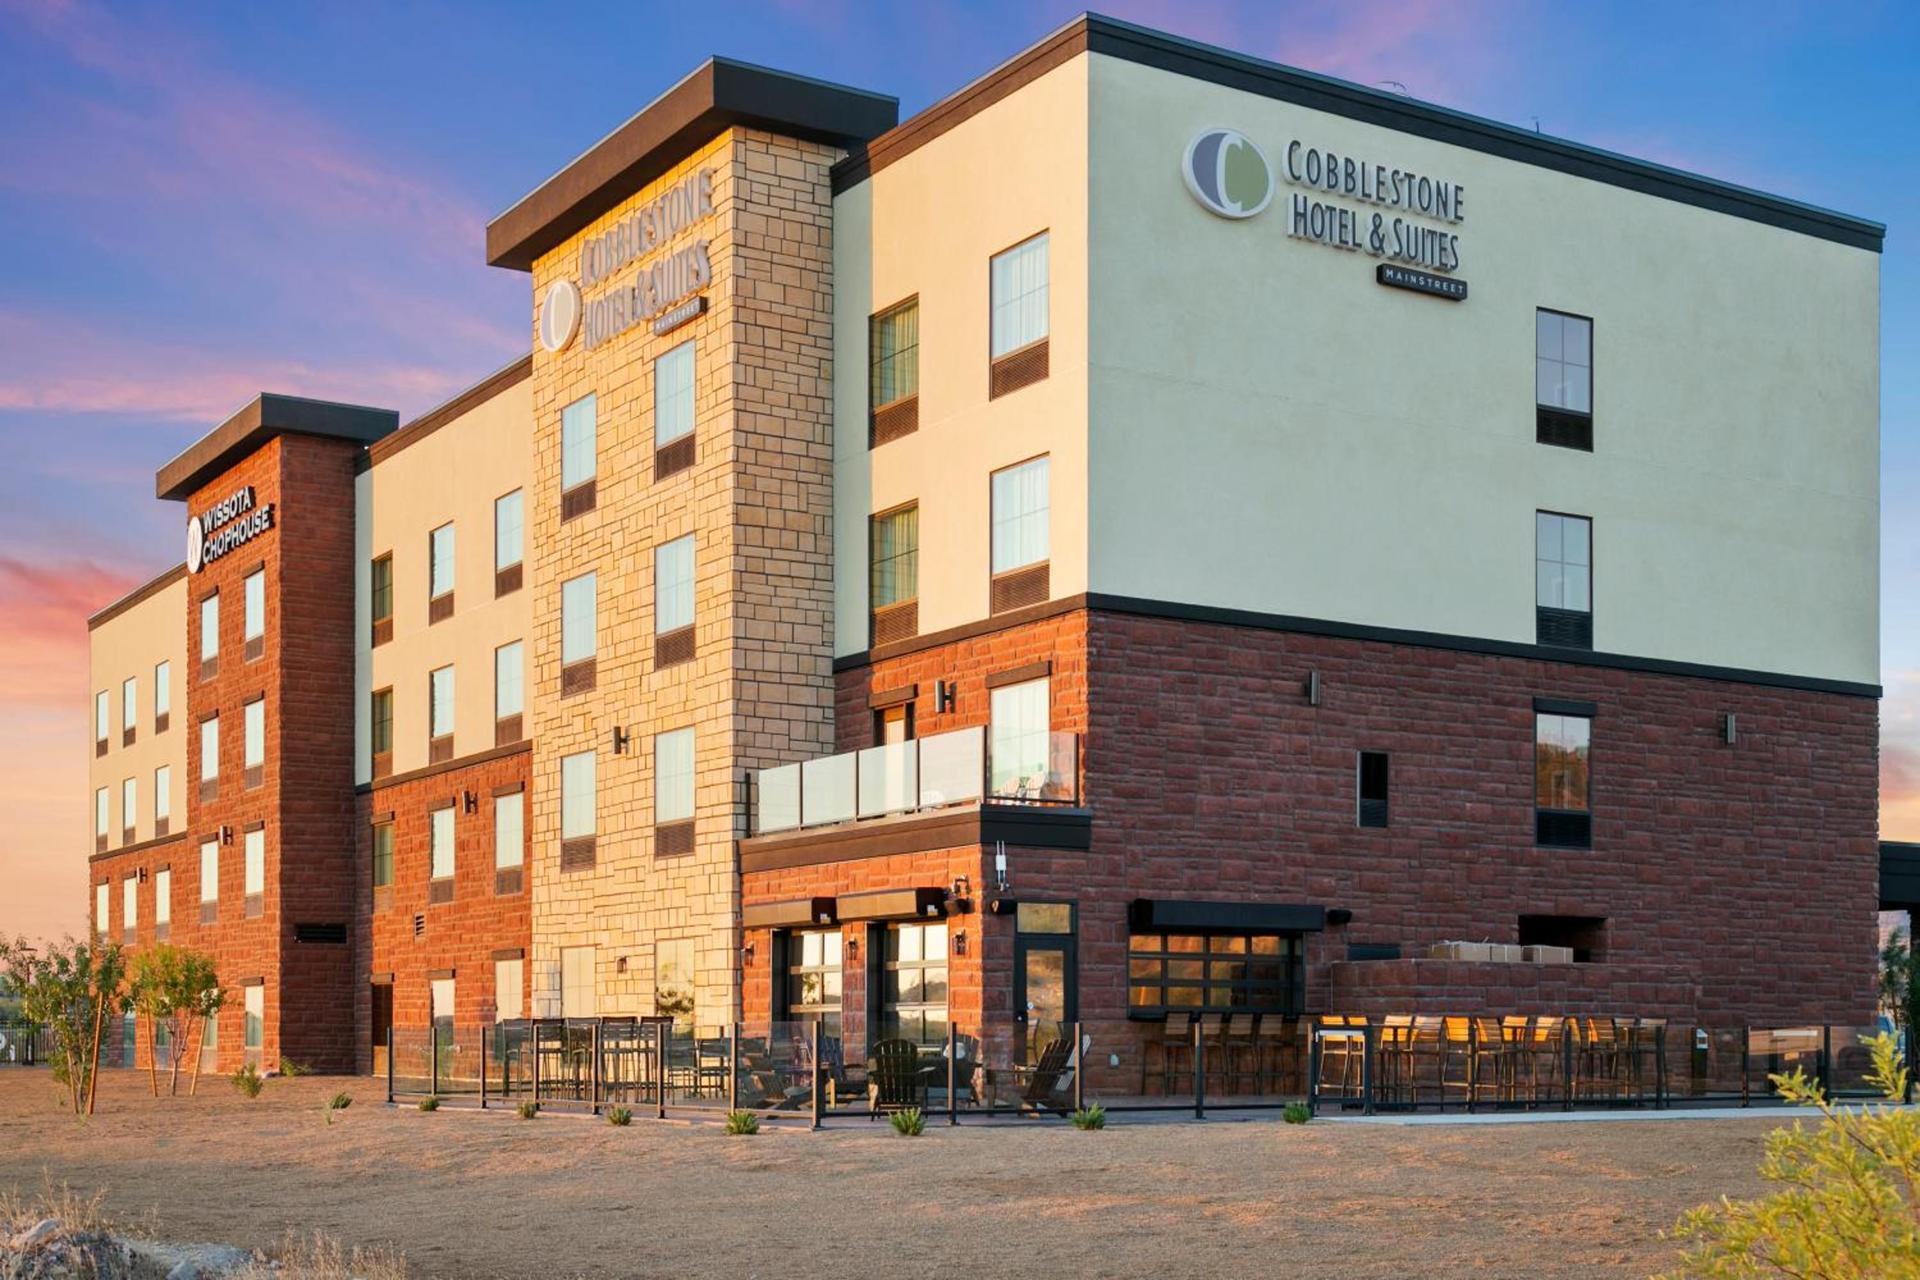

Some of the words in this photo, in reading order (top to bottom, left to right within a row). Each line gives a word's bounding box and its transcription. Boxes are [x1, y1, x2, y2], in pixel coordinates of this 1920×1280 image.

[1286, 140, 1464, 221] COBBLESTONE
[581, 168, 714, 288] COBBLESTONE
[1293, 193, 1363, 249] HOTEL
[1369, 212, 1386, 255] &
[1393, 218, 1460, 271] SUITES
[1385, 268, 1464, 294] MAINSTREET
[202, 486, 252, 534] WISSOTA
[202, 504, 270, 564] CHOPHOUSE
